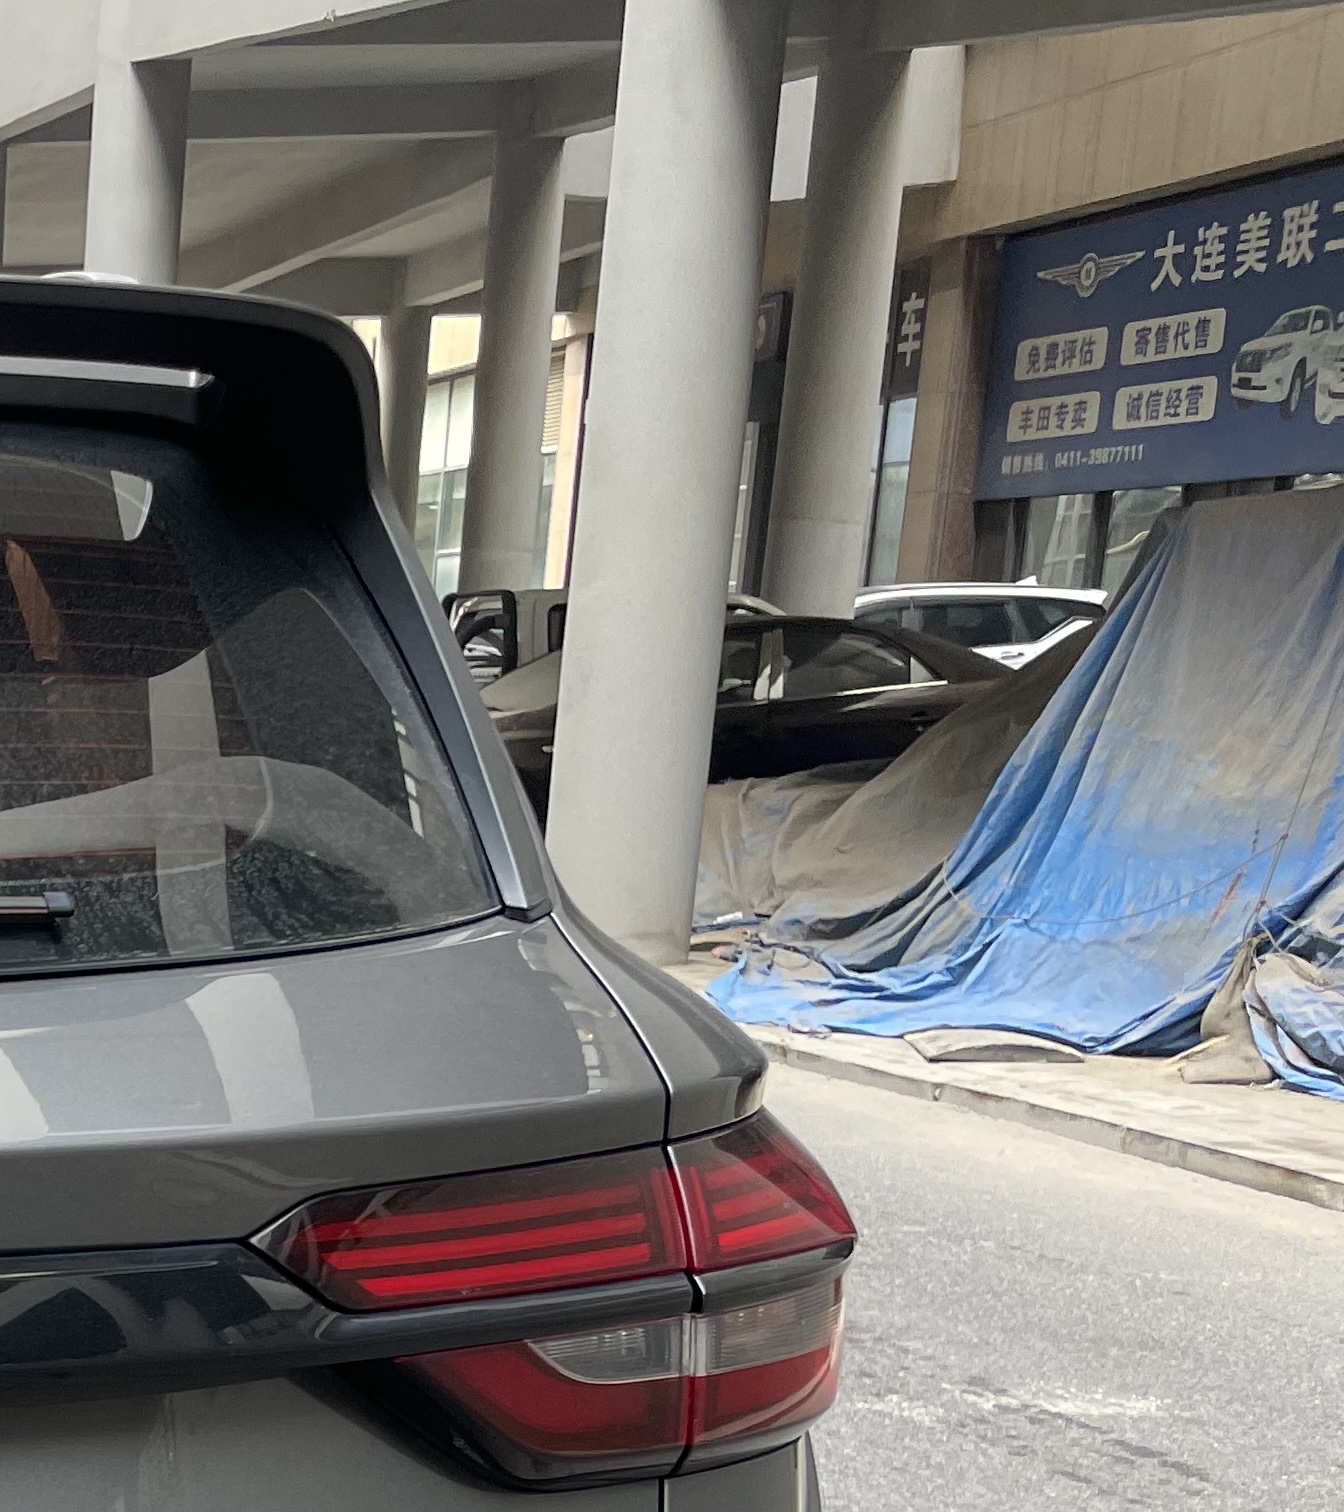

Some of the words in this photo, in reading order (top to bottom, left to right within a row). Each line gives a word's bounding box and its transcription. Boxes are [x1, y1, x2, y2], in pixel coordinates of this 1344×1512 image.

[897, 292, 926, 367] 车
[1133, 316, 1212, 358] 寄售代售
[1025, 335, 1097, 375] 免费评估
[1017, 399, 1088, 436] 丰田专卖
[1125, 384, 1204, 424] 诚信经营
